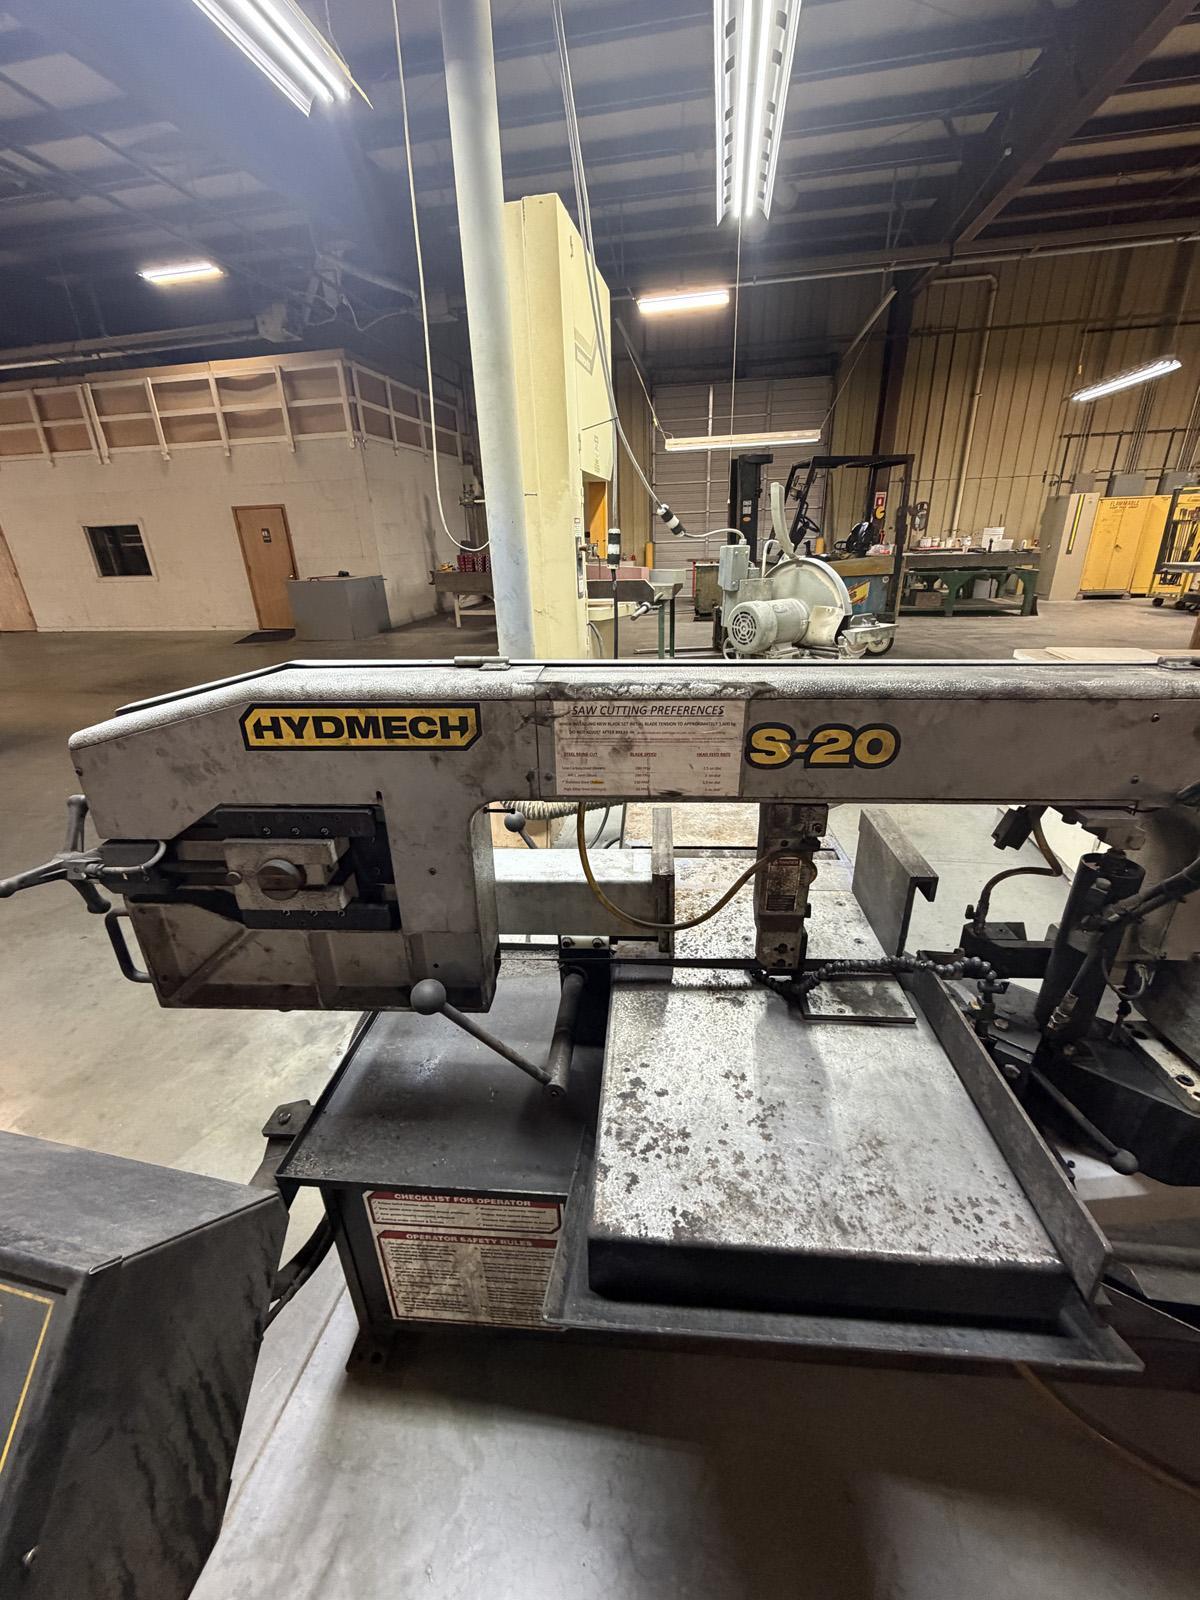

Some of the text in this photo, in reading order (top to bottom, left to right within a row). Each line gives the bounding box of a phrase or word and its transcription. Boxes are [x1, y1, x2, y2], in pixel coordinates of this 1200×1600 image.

[572, 705, 725, 716] SAW CUTTING PREFERENCES
[252, 715, 469, 740] HYDMECH
[746, 724, 899, 767] S-20
[394, 1193, 451, 1202] CHECKLIST
[477, 1198, 531, 1207] OPERATOR
[406, 1233, 533, 1247] OPERATOR SAFETY RULES
